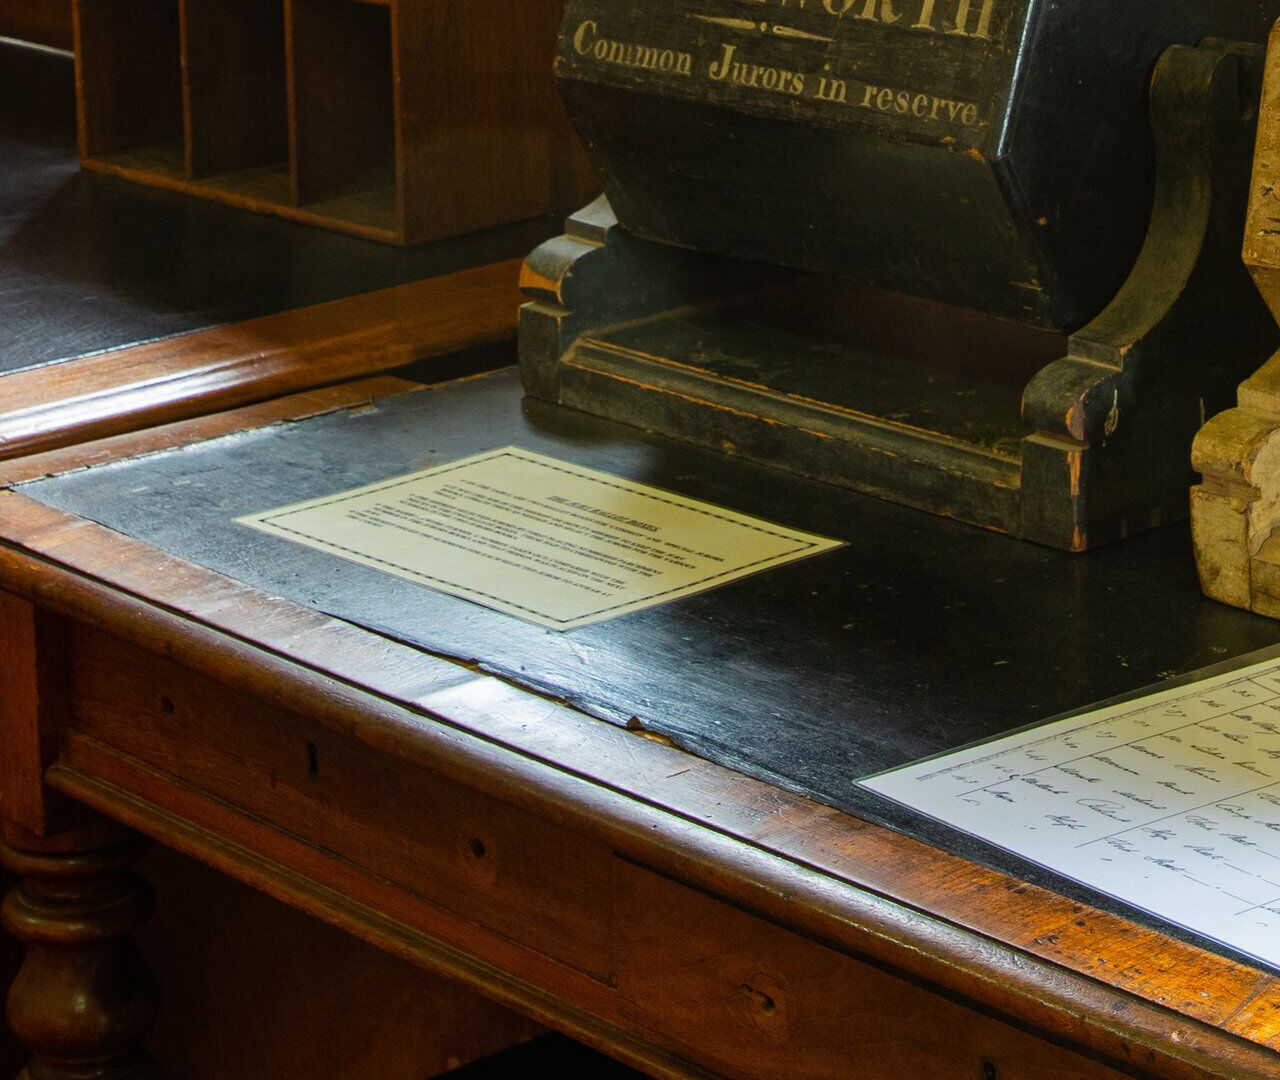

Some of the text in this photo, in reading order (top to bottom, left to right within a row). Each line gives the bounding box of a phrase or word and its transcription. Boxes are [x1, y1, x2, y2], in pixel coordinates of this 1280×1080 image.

[573, 20, 691, 75] Common
[709, 44, 805, 96] Jurors
[816, 65, 847, 103] in
